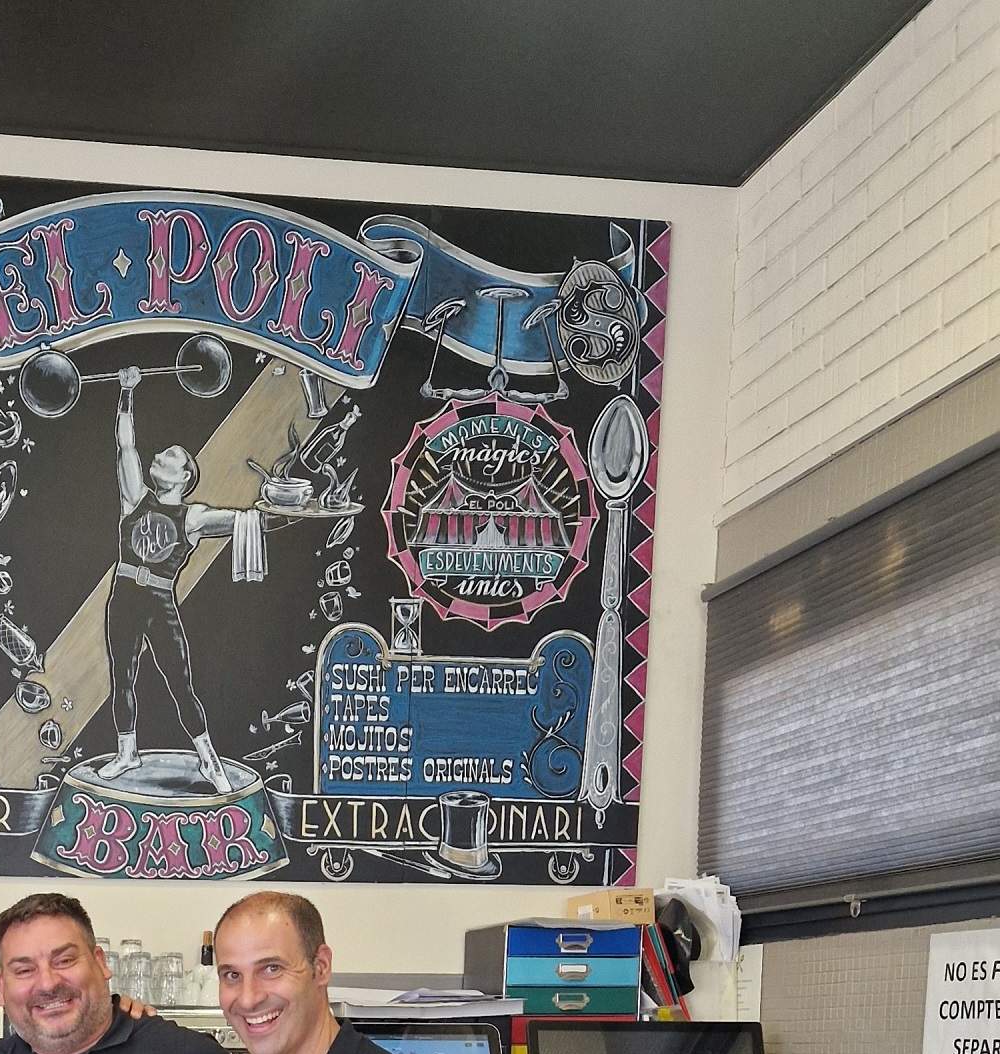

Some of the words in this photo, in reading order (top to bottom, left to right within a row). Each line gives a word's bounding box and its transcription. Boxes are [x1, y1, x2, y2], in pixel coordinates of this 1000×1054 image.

[137, 208, 395, 370] POLI
[441, 417, 543, 450] MOMENTS
[469, 500, 483, 510] EL
[487, 499, 515, 511] POLI
[426, 552, 554, 575] ESDEVENIMENTS
[331, 663, 387, 692] SUSHI
[396, 665, 435, 693] PER
[444, 664, 539, 695] ENCÀRREC
[330, 695, 391, 722] TAPES
[328, 725, 414, 752] MOJITOS
[328, 756, 413, 782] POSTRES
[422, 758, 513, 785] ORIGINALS
[56, 794, 269, 880] BAR
[944, 961, 967, 982] NO
[971, 960, 987, 981] ES
[939, 1000, 1000, 1020] COMPTE
